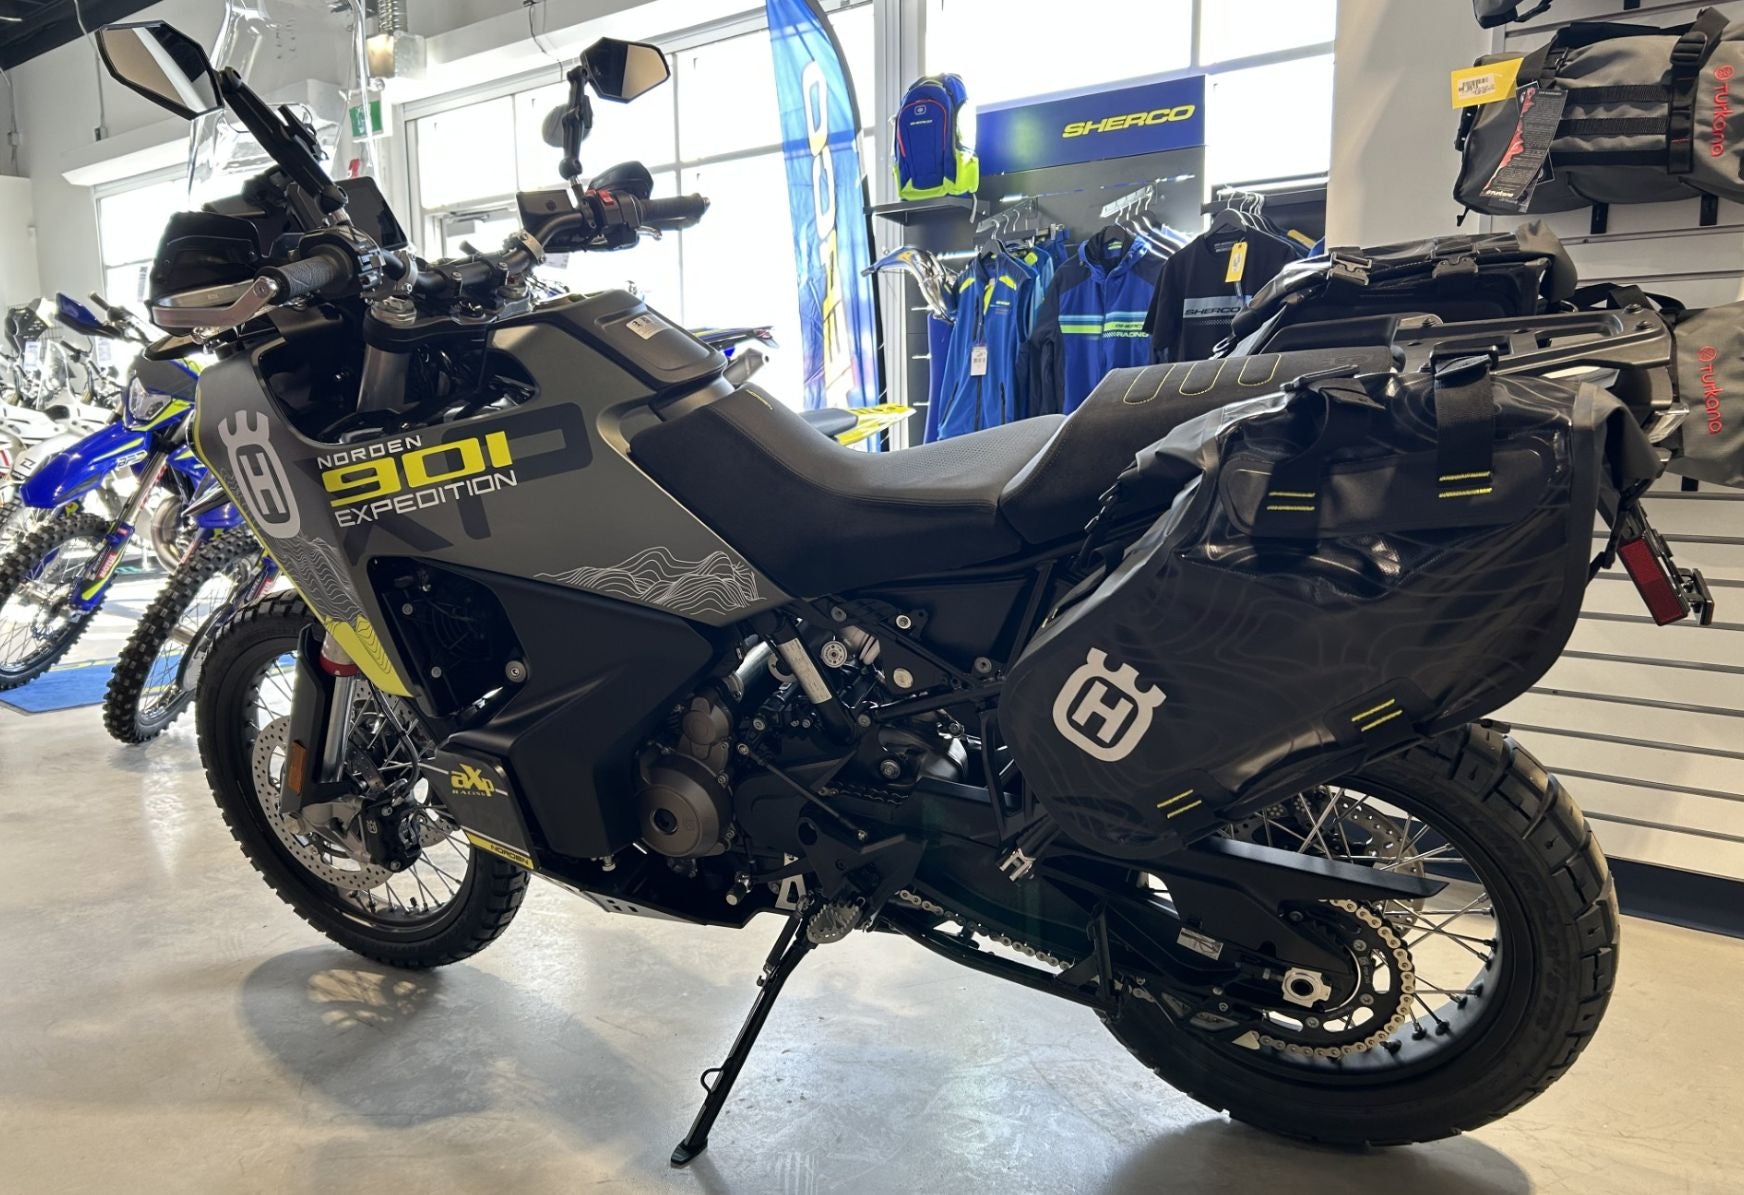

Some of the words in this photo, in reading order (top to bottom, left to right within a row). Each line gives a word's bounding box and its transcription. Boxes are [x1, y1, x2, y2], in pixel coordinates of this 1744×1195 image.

[1062, 104, 1196, 138] SHERCO
[1184, 306, 1240, 316] SHERCO
[317, 434, 422, 470] NORDEN
[321, 430, 513, 508] 901
[334, 470, 518, 528] EXPEDITION
[490, 844, 530, 866] NORDEN
